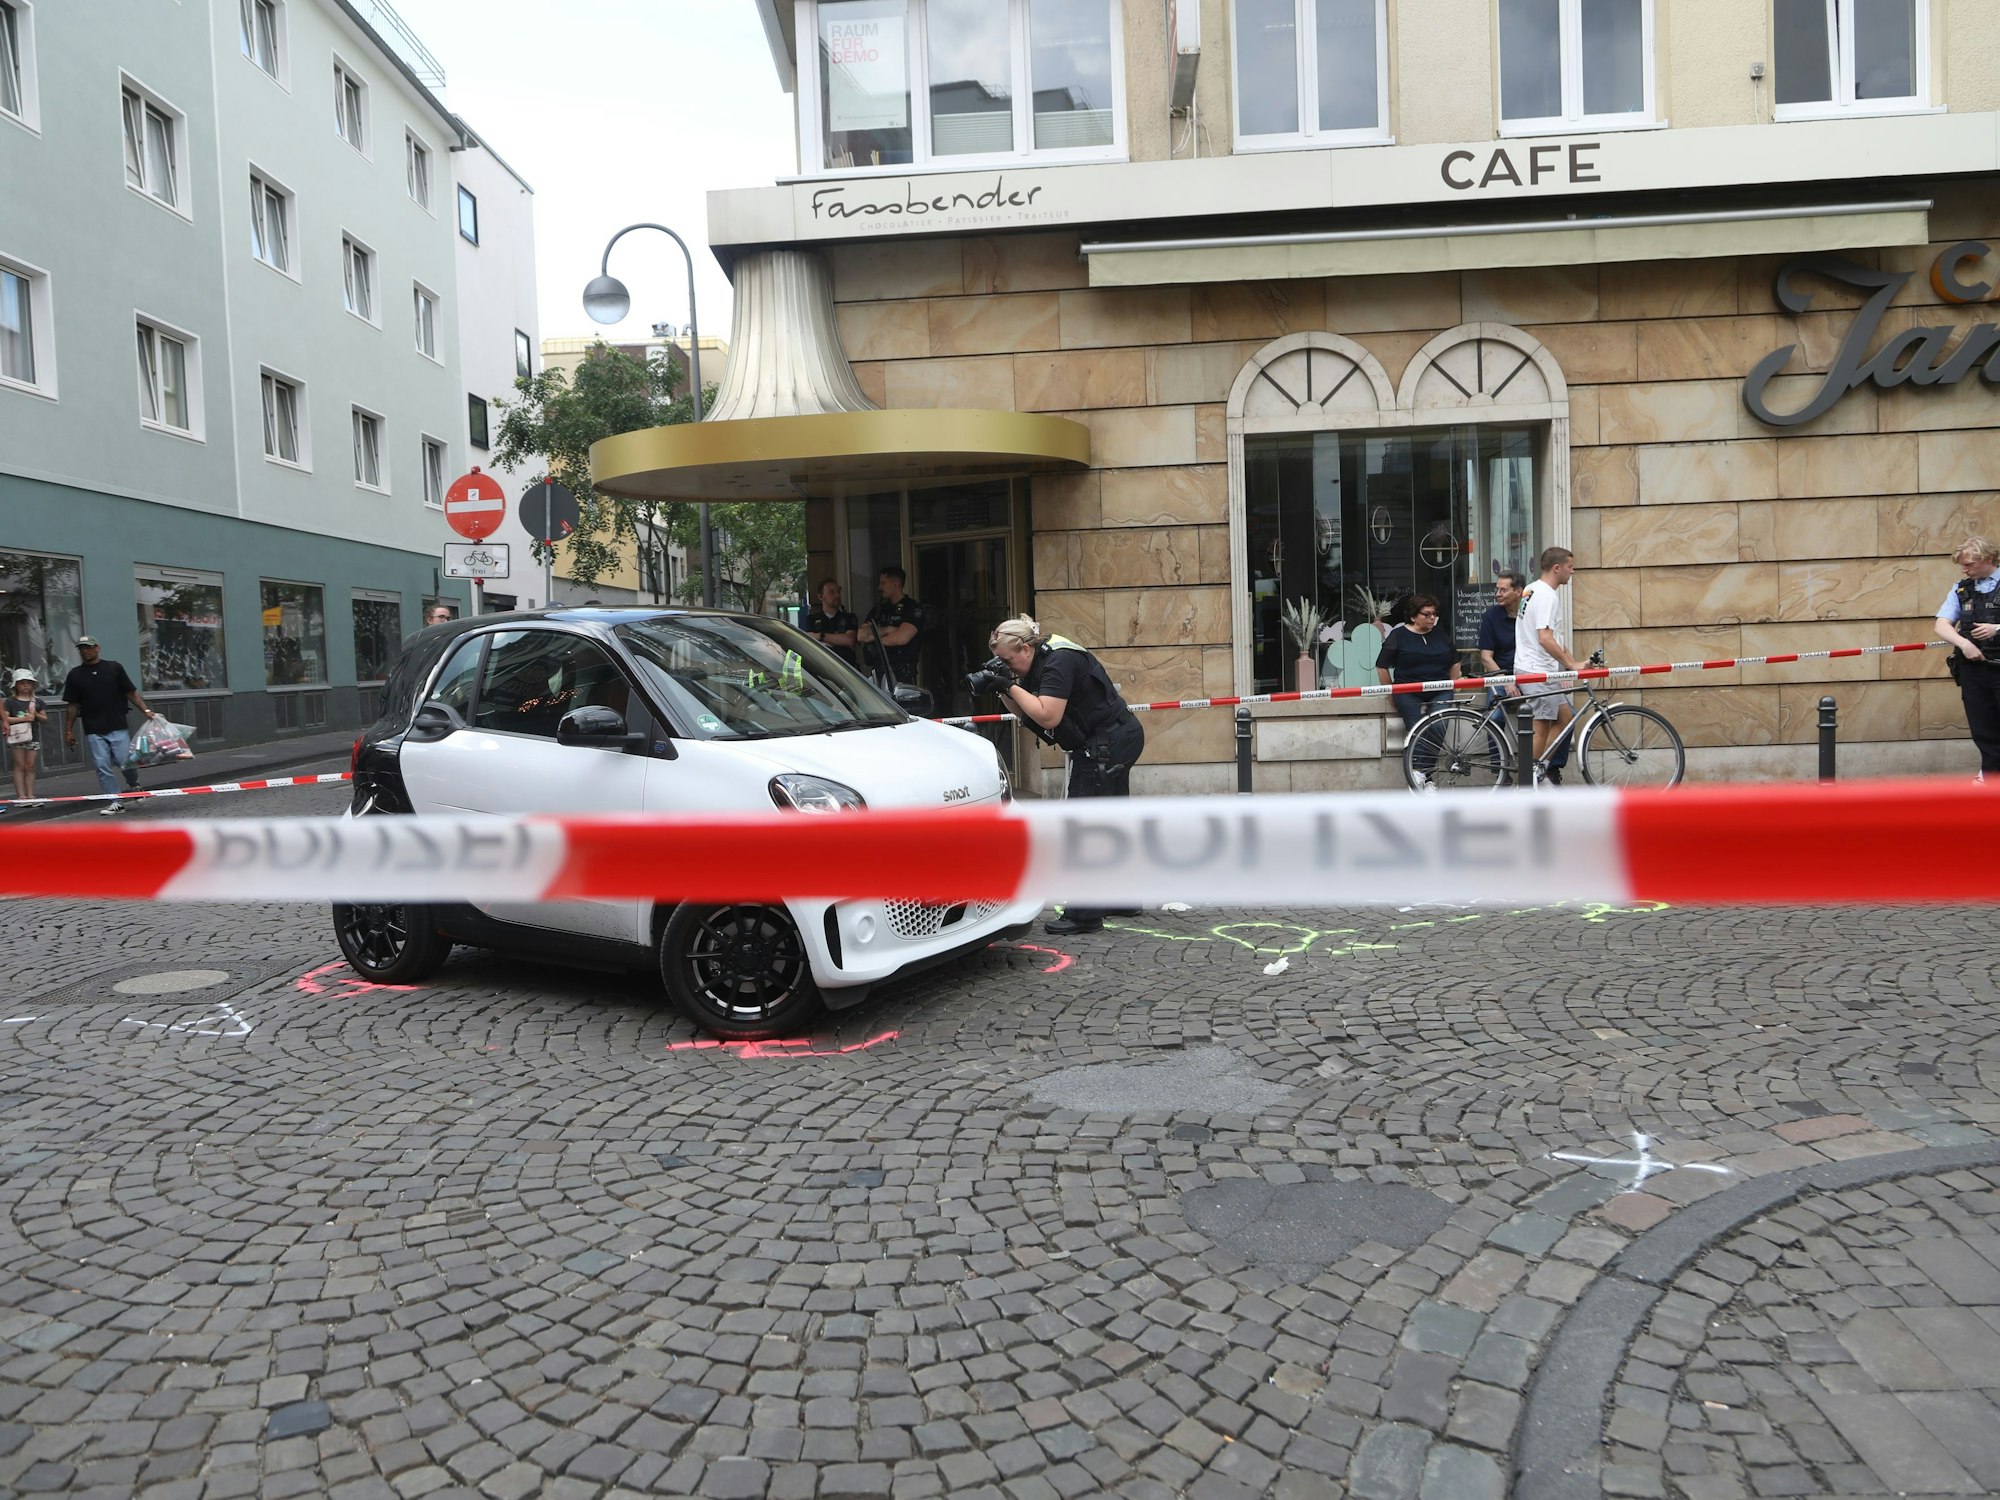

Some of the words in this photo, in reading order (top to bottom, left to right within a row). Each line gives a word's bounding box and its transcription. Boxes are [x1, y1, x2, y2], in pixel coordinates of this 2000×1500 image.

[831, 23, 879, 38] RAUM
[831, 37, 864, 51] FÜR
[832, 49, 880, 64] DEMO
[1440, 142, 1602, 191] CAFE
[811, 174, 1043, 220] Fassbender
[1930, 241, 2000, 303] C
[943, 785, 970, 802] smart
